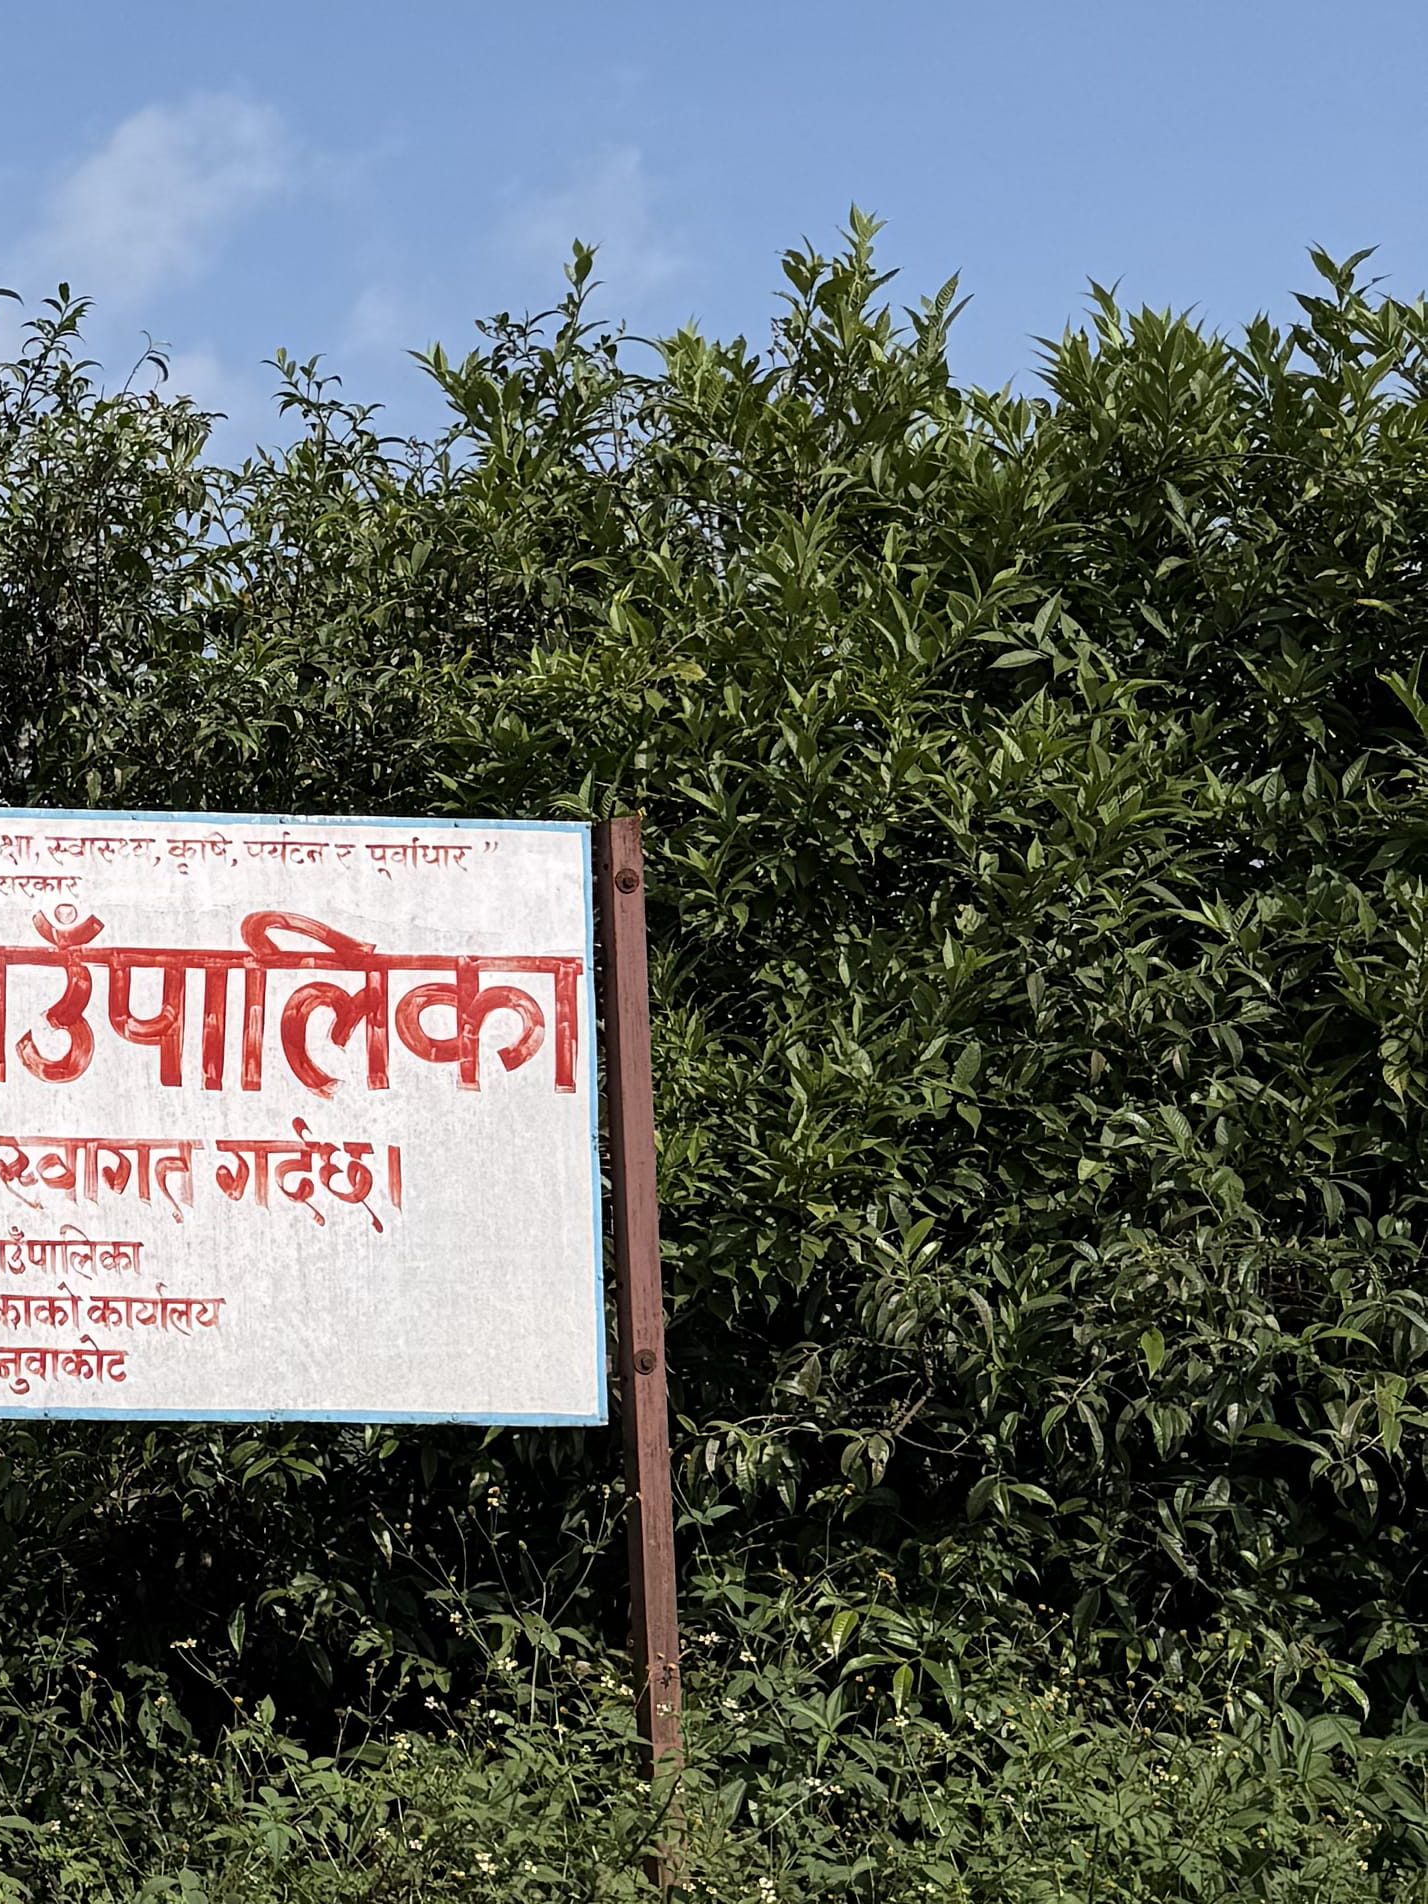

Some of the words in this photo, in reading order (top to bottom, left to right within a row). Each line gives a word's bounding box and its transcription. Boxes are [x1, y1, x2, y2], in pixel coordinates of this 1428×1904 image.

[243, 831, 330, 866] पर्यटन
[334, 843, 357, 870] र
[87, 1283, 226, 1336] कार्यालय
